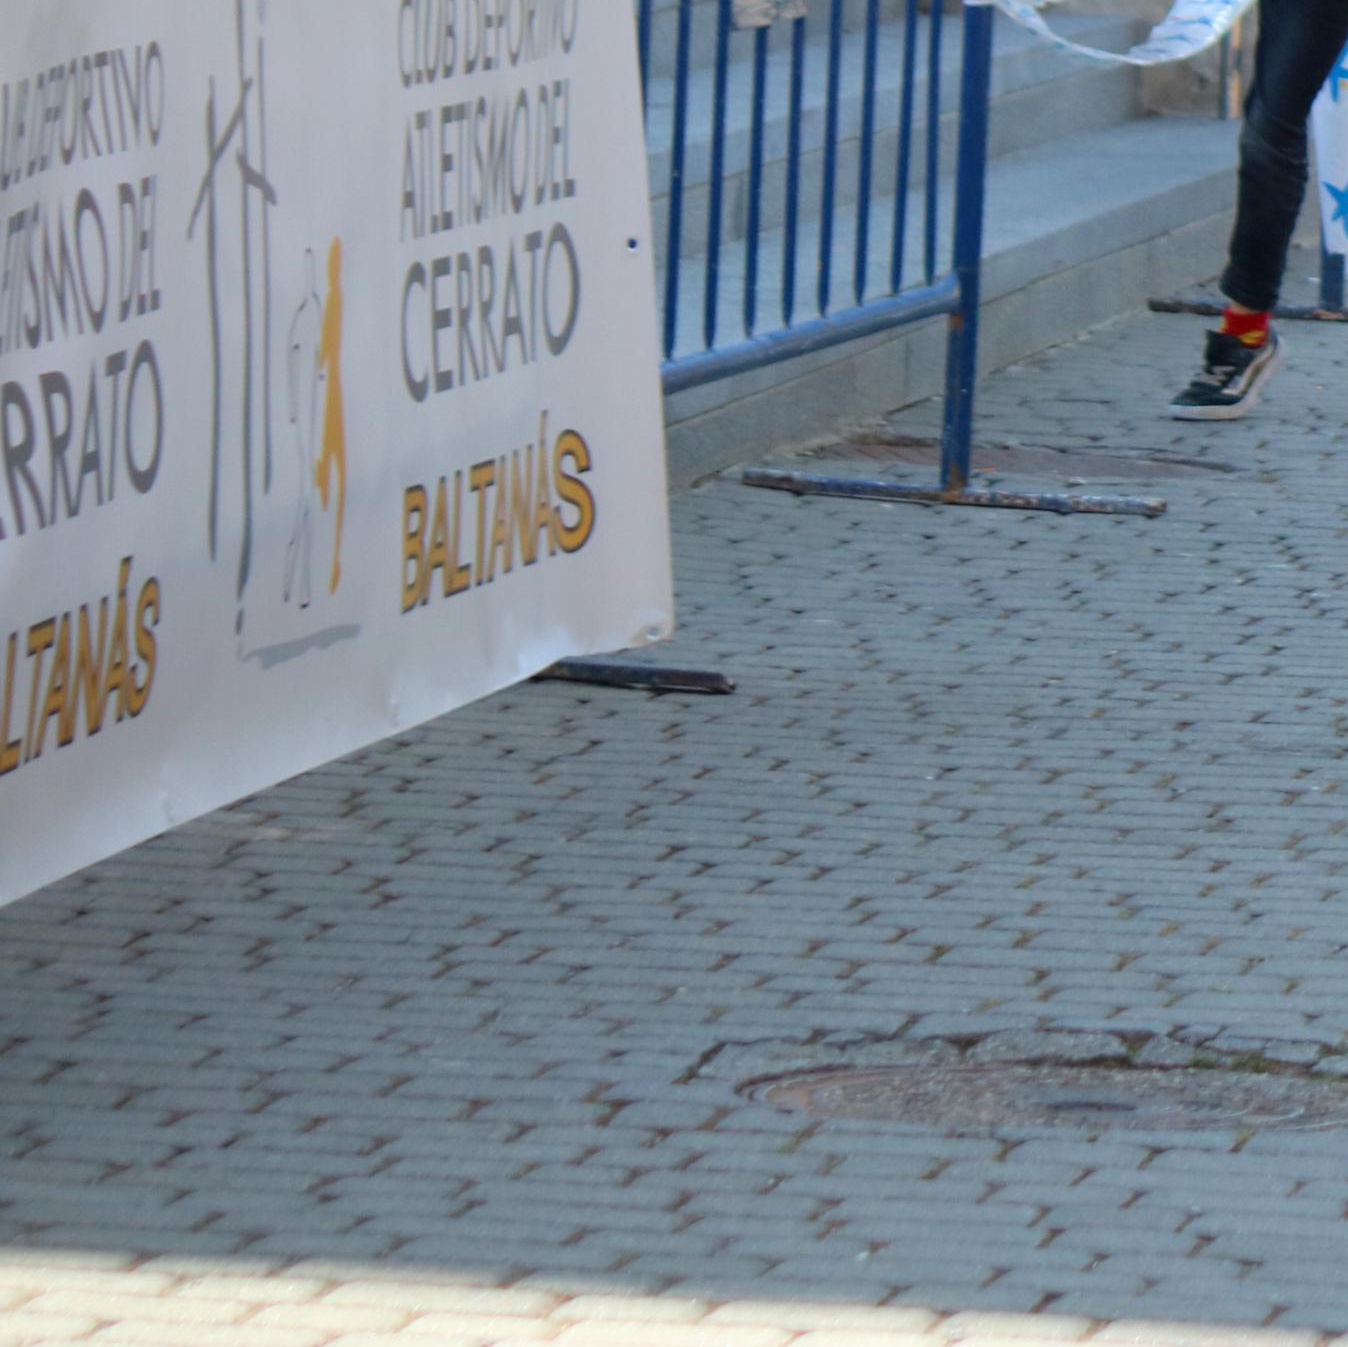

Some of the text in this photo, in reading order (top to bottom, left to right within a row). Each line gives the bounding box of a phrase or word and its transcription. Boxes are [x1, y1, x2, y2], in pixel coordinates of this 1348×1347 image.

[117, 173, 161, 323] DEL
[400, 78, 575, 242] ATLETISMO DEL
[402, 221, 580, 404] CERRATO
[0, 339, 164, 540] RRATO
[401, 409, 595, 614] BALTANÁS
